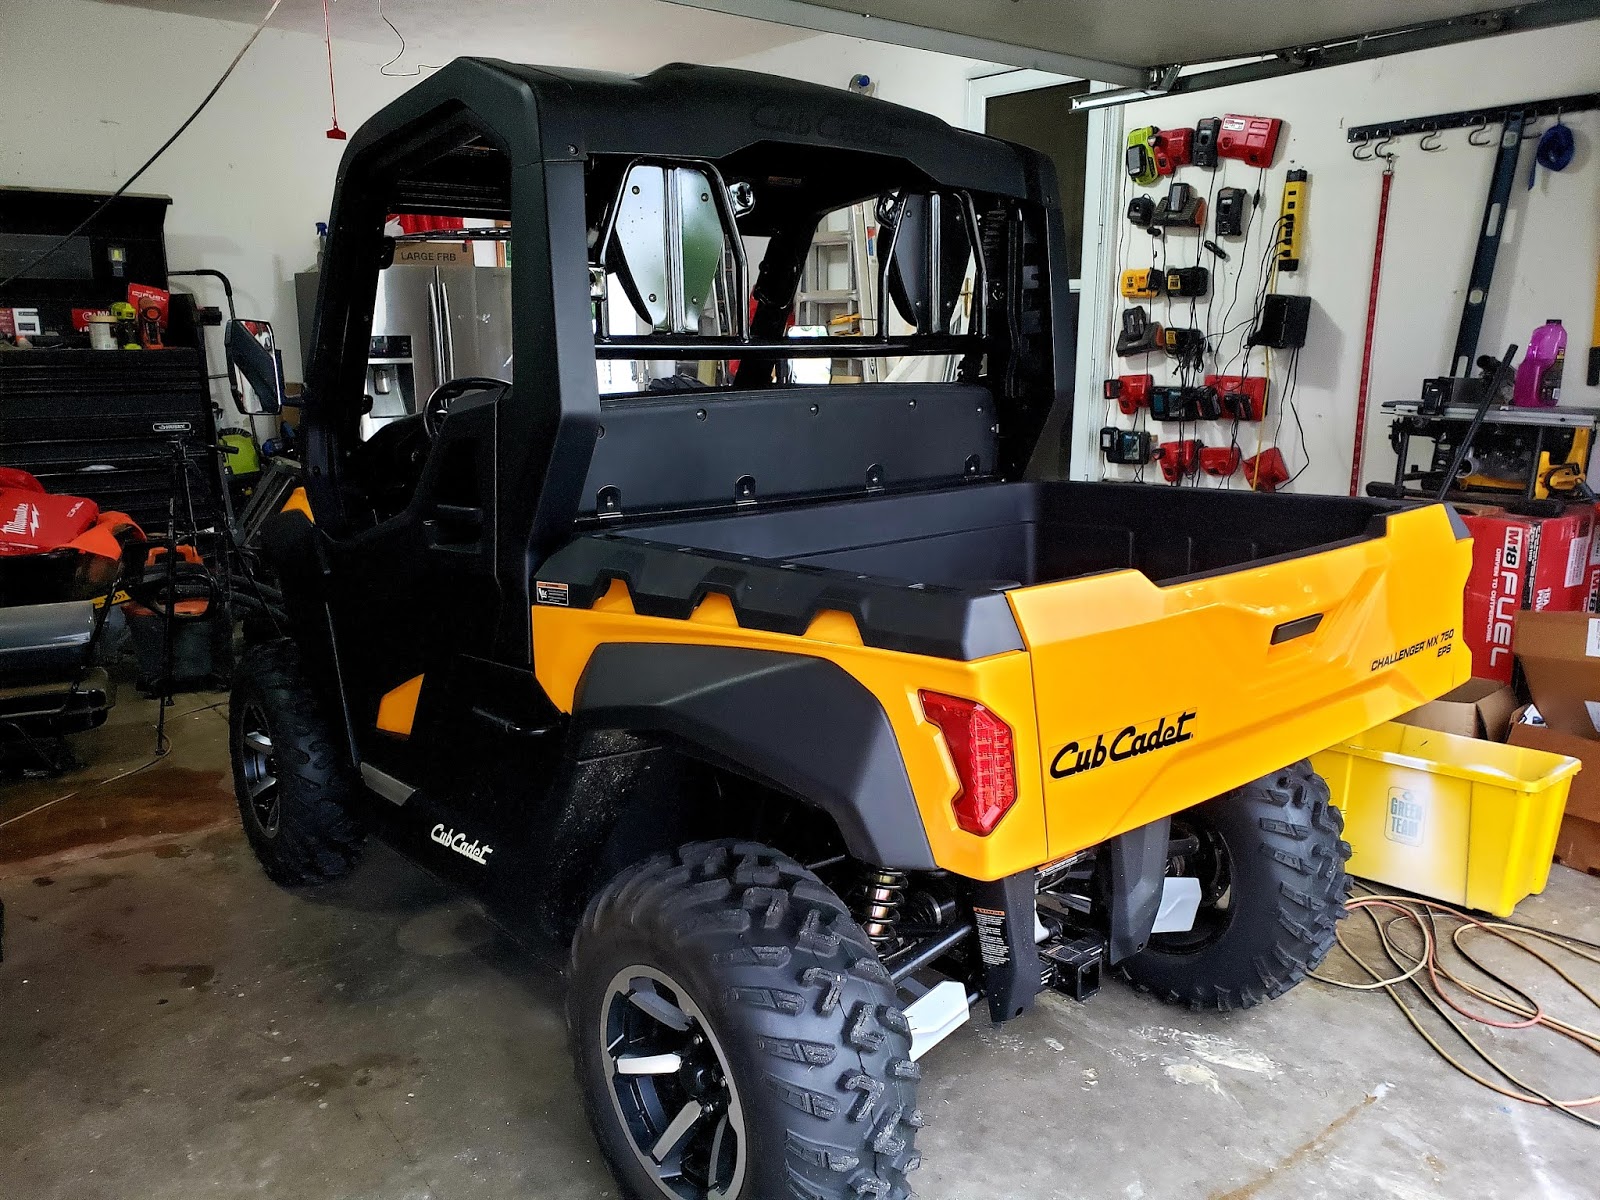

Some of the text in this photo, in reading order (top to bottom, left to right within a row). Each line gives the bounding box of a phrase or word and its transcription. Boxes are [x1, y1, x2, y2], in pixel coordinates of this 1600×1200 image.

[401, 252, 434, 261] LARGE
[1492, 548, 1502, 577] DRIVEN
[1489, 530, 1520, 667] M18 FUEL
[1491, 577, 1498, 589] TO
[1371, 629, 1455, 671] CHALLENGER MX 750
[1437, 644, 1452, 657] EPS
[1050, 711, 1197, 779] Cub Cadet
[431, 823, 494, 866] Cub Cadet
